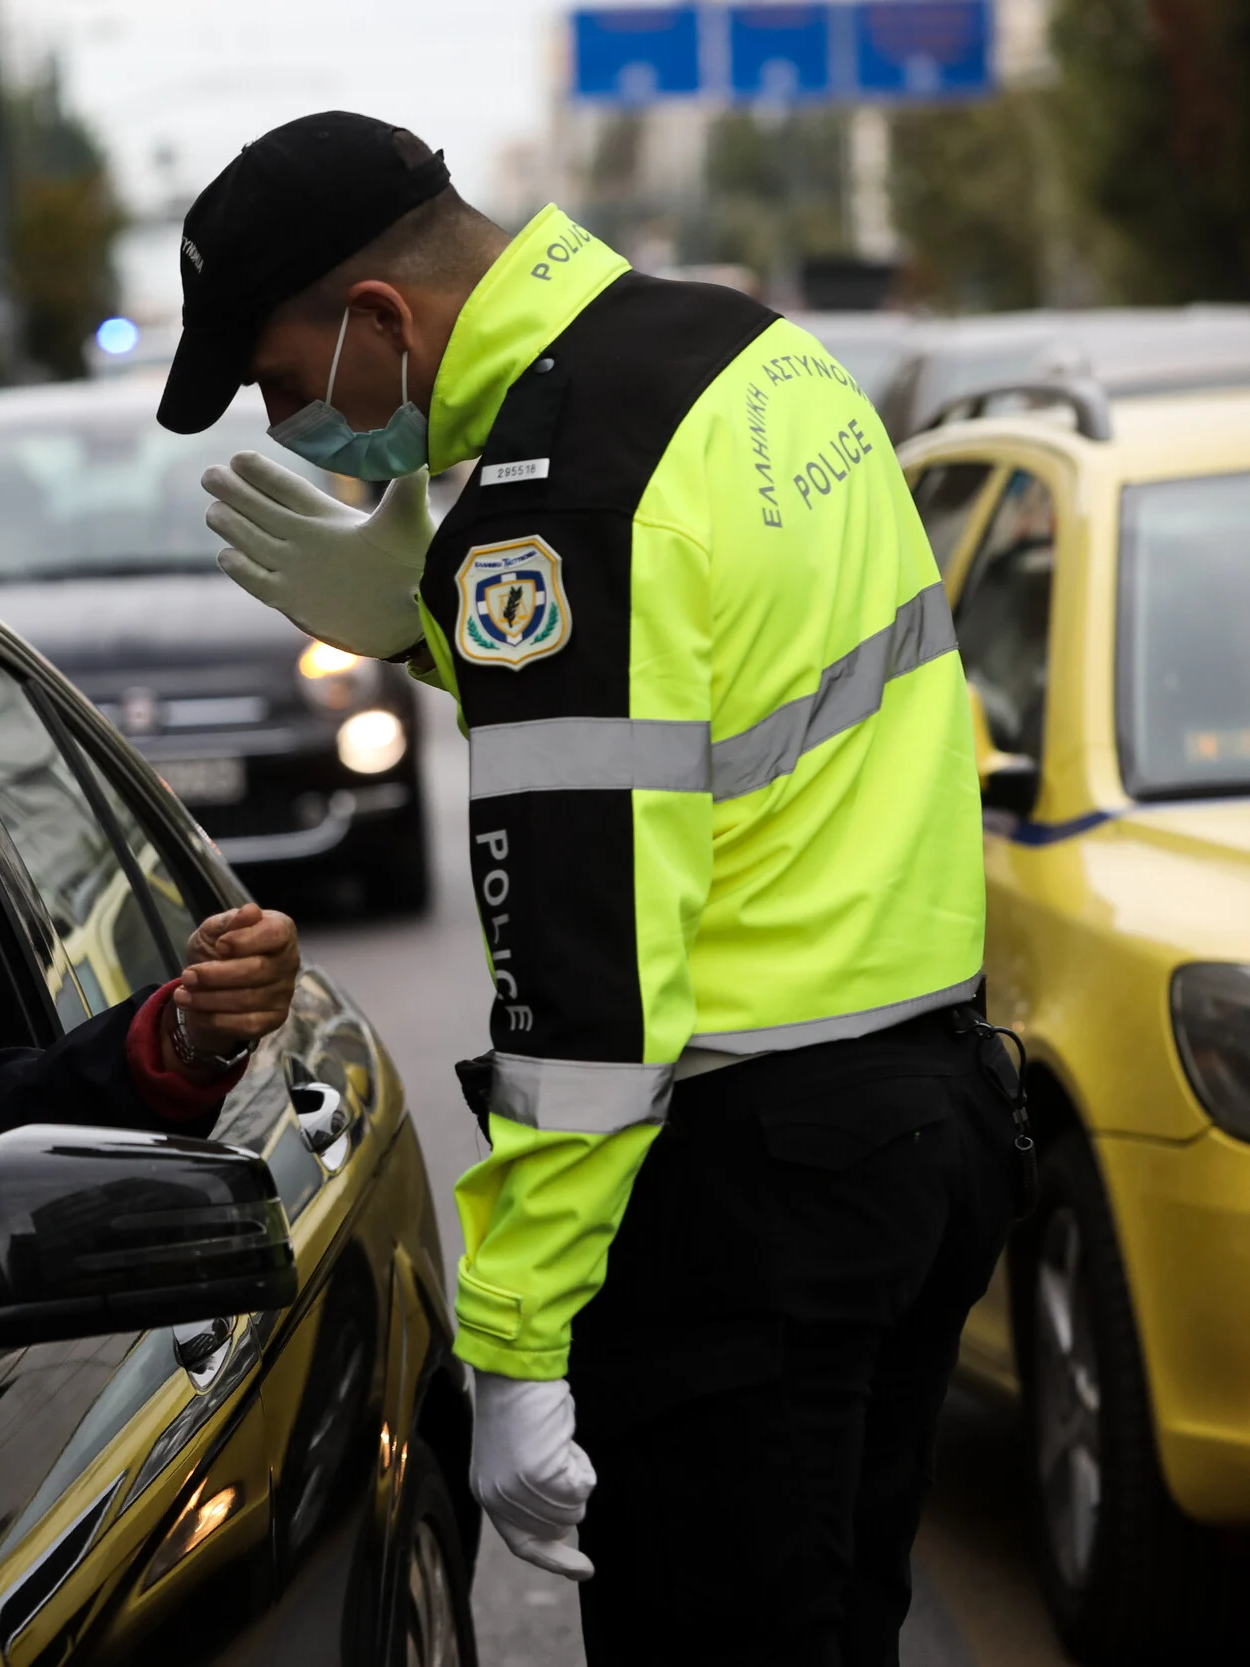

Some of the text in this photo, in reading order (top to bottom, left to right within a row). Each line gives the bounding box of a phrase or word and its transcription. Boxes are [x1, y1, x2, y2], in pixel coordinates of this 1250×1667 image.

[746, 382, 783, 529] ΕΛΛΗΝΙΚΗ
[793, 418, 874, 511] POLICE
[475, 829, 534, 1032] POLICE
